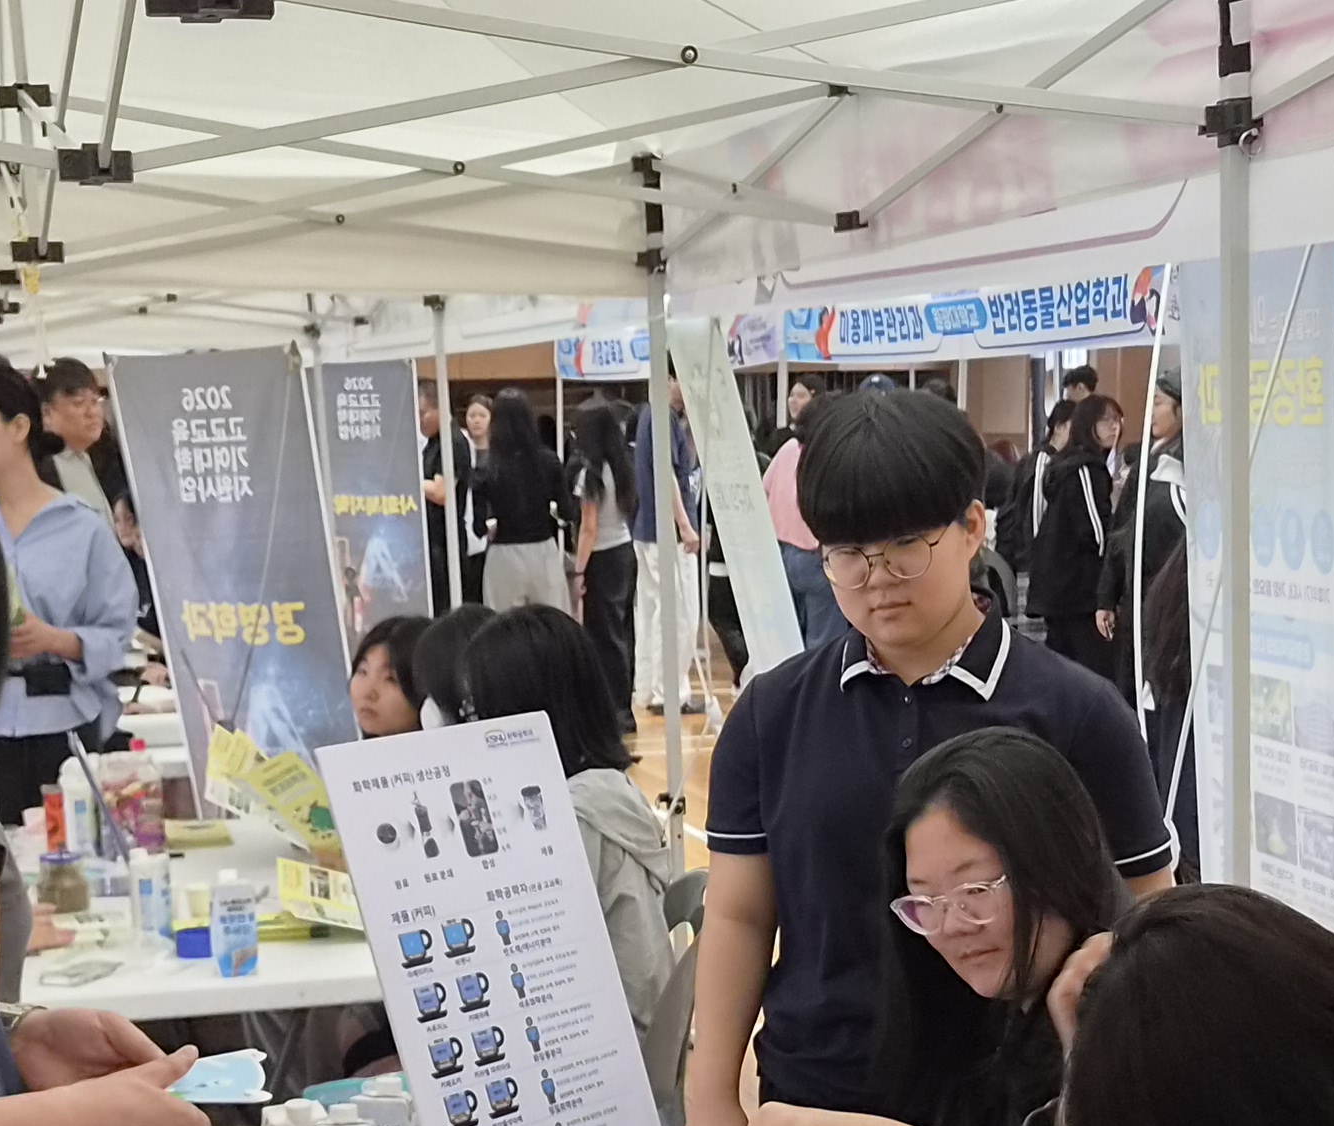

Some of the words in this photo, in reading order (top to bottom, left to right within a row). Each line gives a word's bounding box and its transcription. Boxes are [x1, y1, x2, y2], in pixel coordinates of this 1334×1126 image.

[838, 304, 924, 345] 미용피부관리과
[987, 273, 1129, 336] 반려동물산업학과
[352, 776, 390, 794] 화학제품
[416, 765, 451, 783] 생산공정
